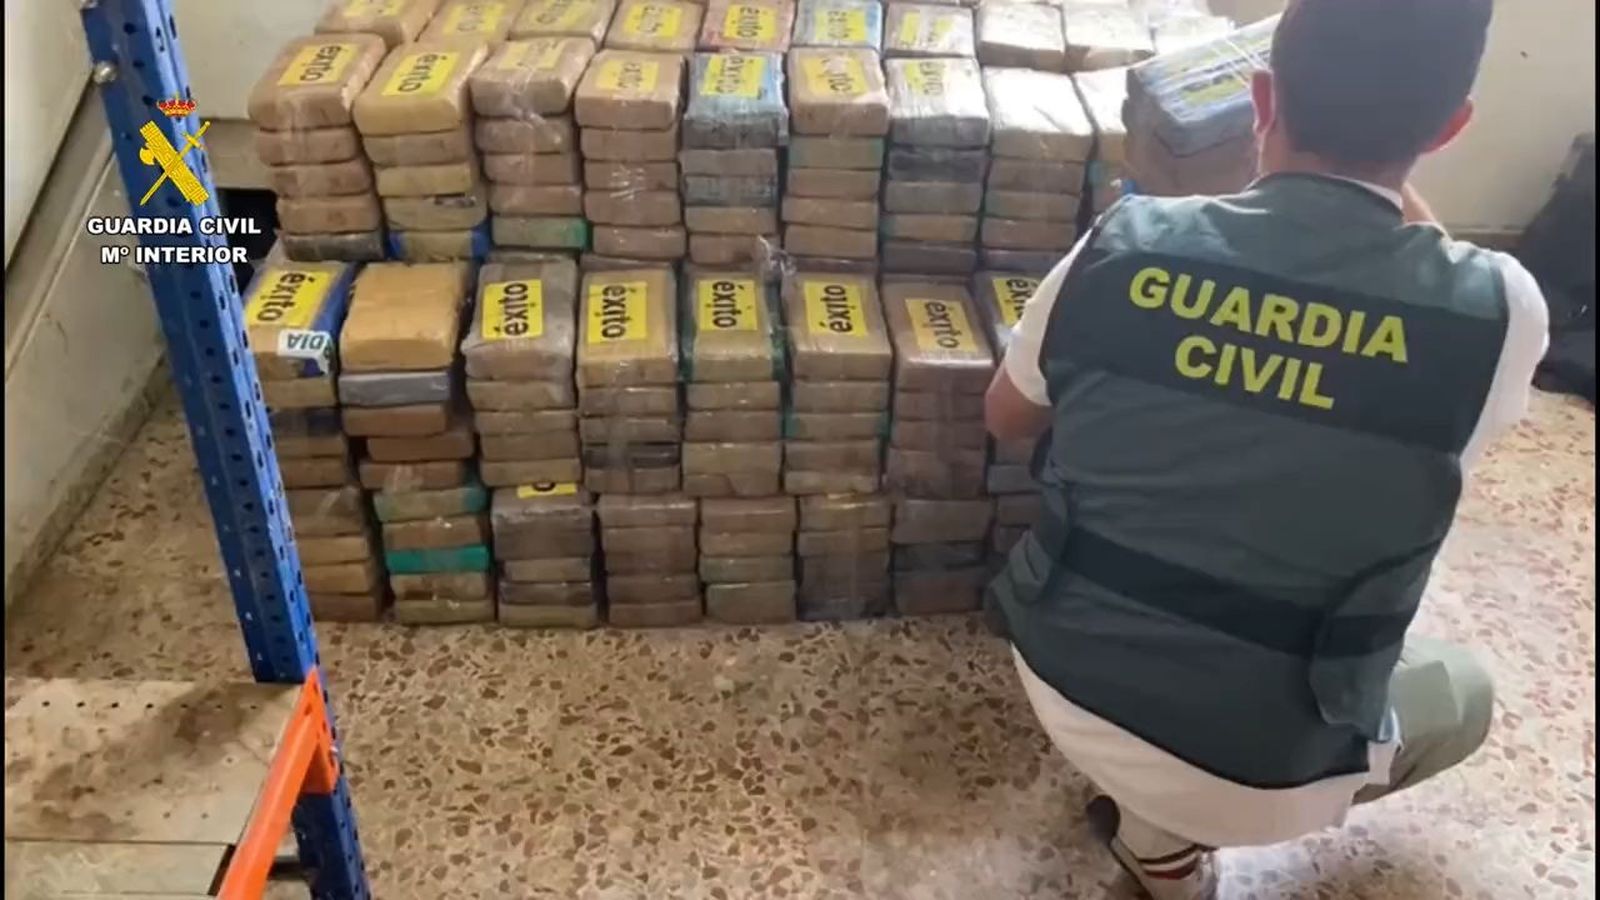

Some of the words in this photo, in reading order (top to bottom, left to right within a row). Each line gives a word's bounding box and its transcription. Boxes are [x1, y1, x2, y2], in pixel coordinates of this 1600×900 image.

[397, 53, 448, 92] éxito
[256, 271, 315, 322] éxito
[493, 282, 537, 337] éxito
[594, 284, 637, 339] éxito
[705, 280, 745, 329] éxito
[818, 284, 856, 333] éxito
[1128, 266, 1409, 363] GUARDIA
[287, 332, 326, 350] DIA
[922, 301, 963, 349] éxito
[1174, 335, 1336, 410] CIVIL
